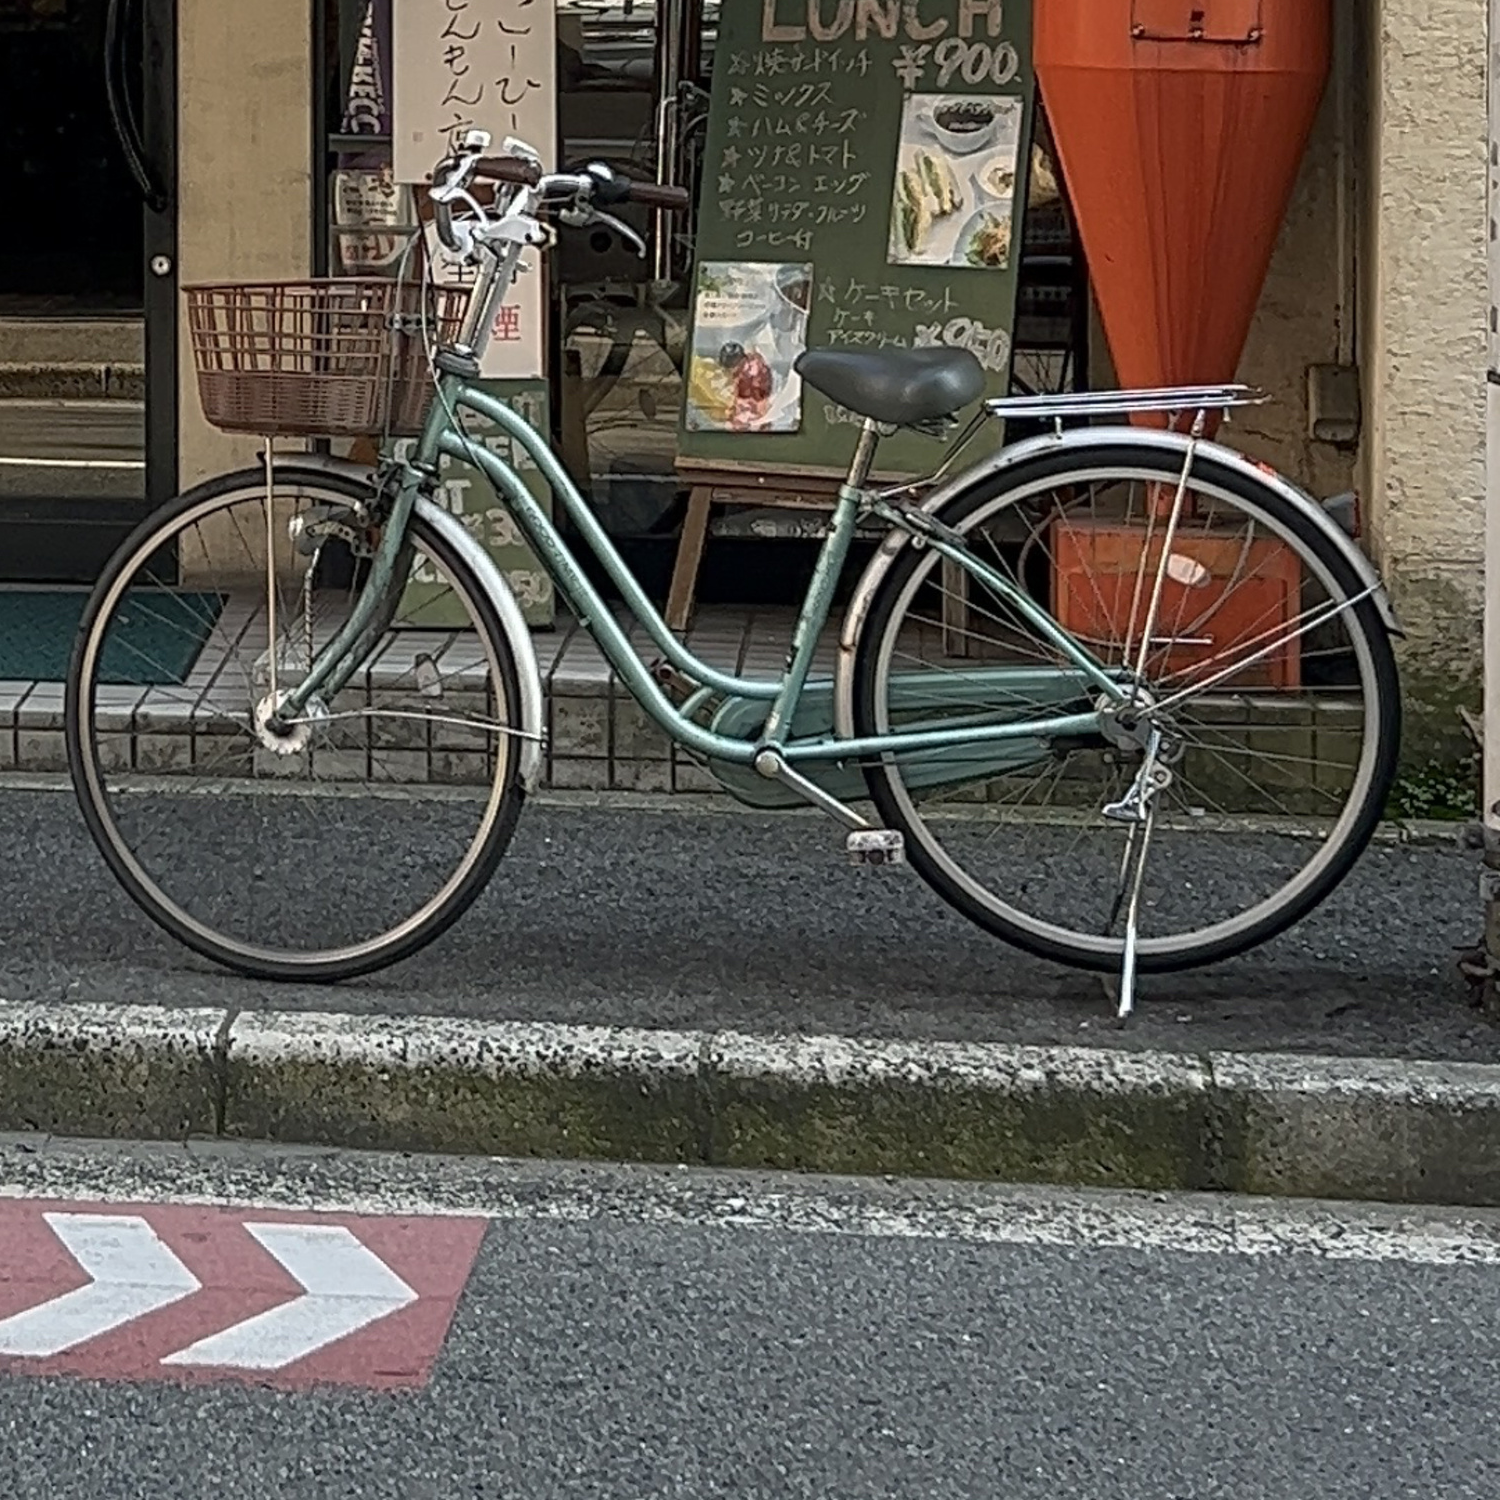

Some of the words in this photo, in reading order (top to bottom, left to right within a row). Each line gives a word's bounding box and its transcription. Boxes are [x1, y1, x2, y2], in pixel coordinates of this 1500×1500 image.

[752, 82, 834, 108] ミックス
[845, 279, 960, 313] ケーキセット
